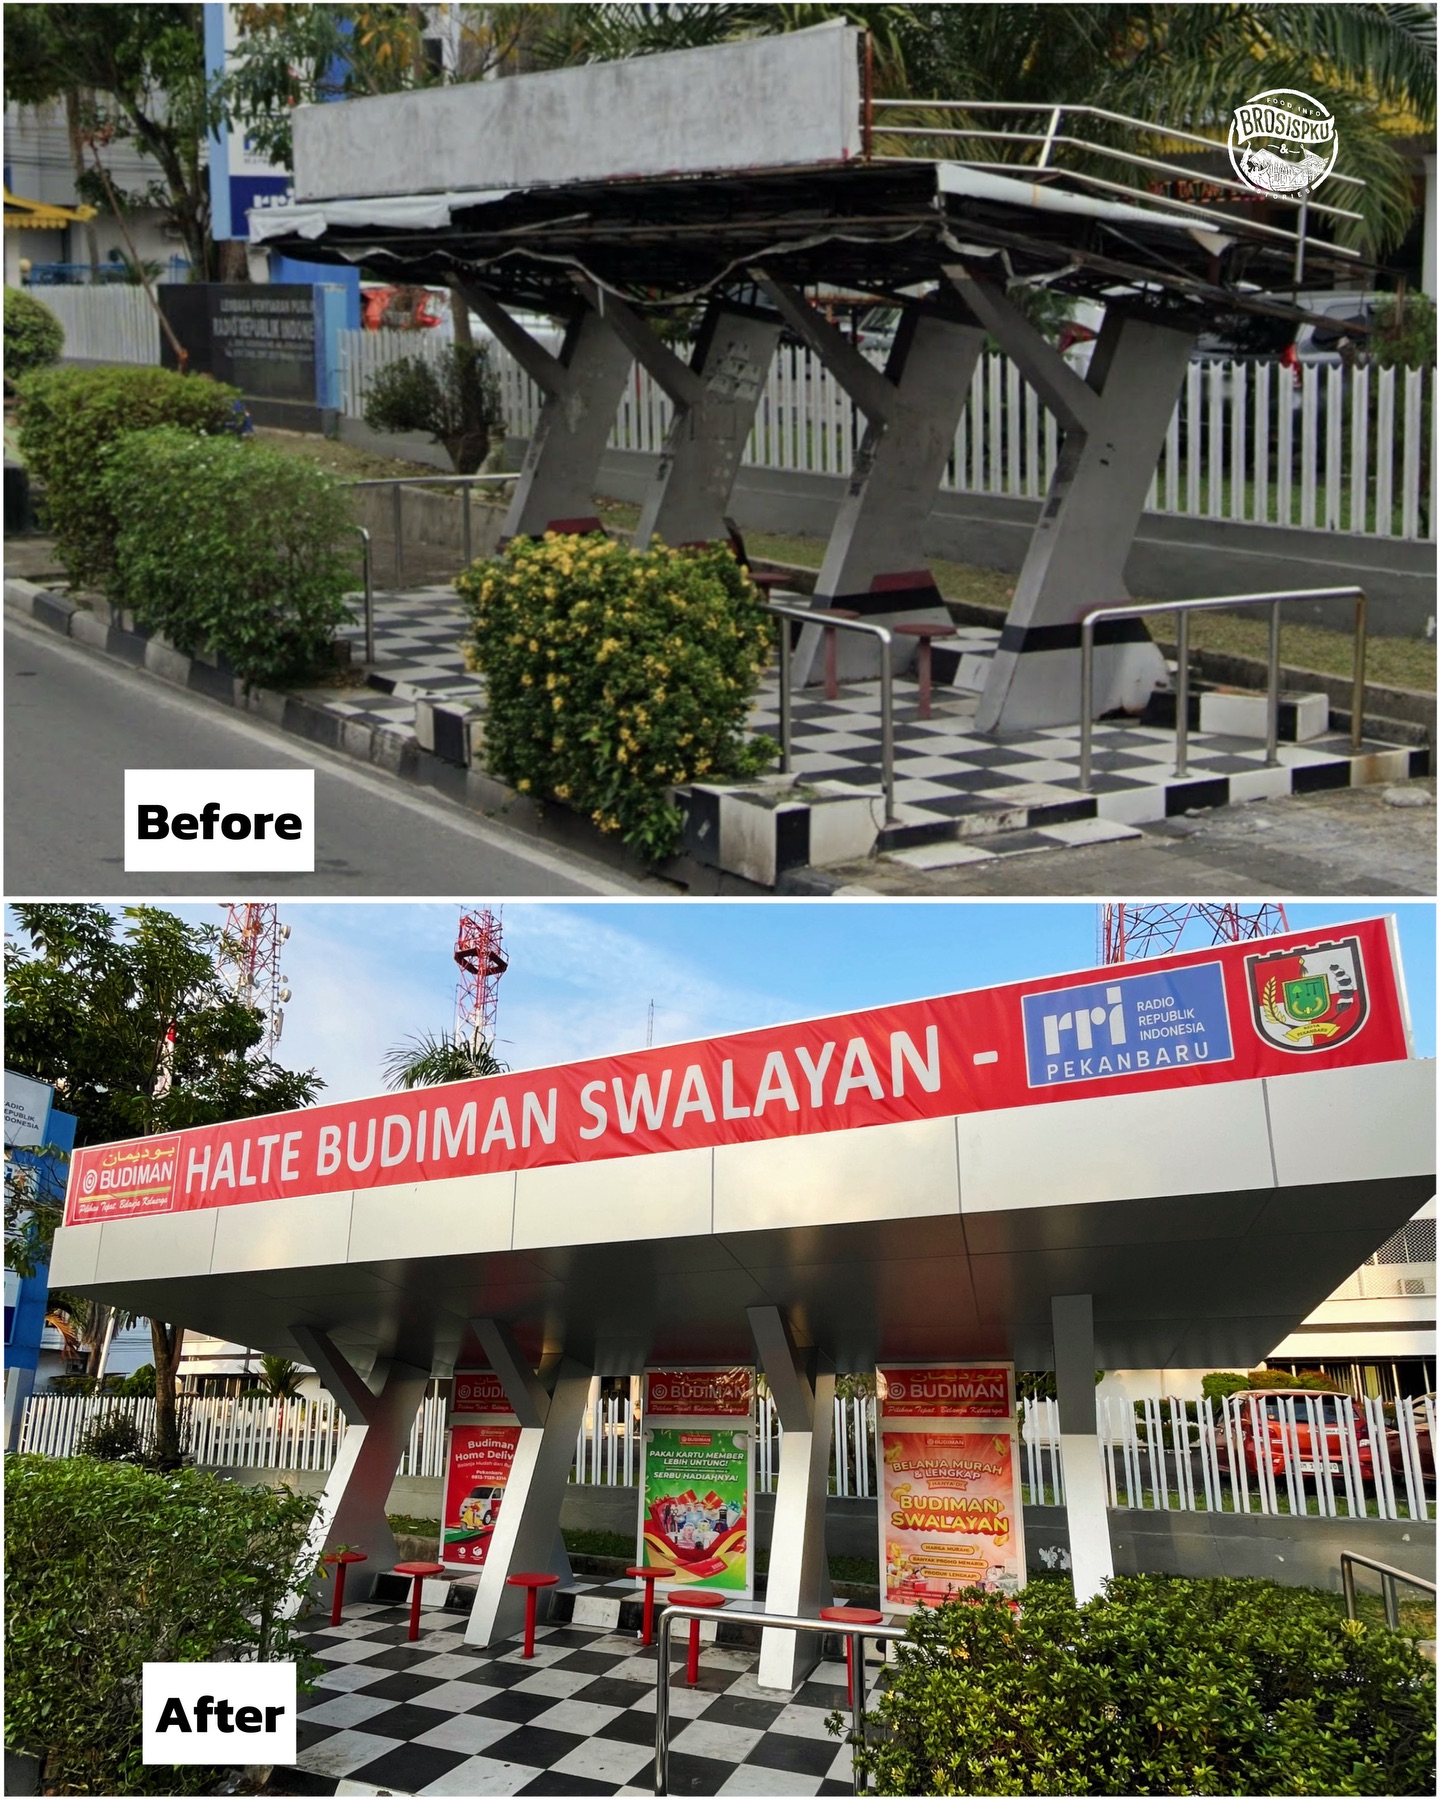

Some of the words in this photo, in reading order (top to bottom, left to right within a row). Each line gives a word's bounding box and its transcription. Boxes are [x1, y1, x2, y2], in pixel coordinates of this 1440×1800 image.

[1136, 996, 1175, 1012] RADIO
[1043, 985, 1127, 1056] rri
[1138, 1008, 1195, 1027] REPUBLIK
[1139, 1021, 1205, 1041] INDONESIA
[1046, 1041, 1209, 1081] PEKANBARU
[4, 1101, 25, 1111] ADIO
[185, 1130, 302, 1194] HALTE
[316, 1088, 558, 1177] BUDIMAN
[579, 1024, 942, 1141] SWALAYAN
[4, 1115, 40, 1130] DONESIA
[100, 1160, 174, 1190] BUDIMAN
[910, 1383, 1004, 1399] BUDIMAN
[467, 1438, 515, 1451] Budiman
[934, 1438, 964, 1446] BUDIMAN
[455, 1452, 485, 1462] Home
[649, 1450, 674, 1458] PAKAI
[675, 1451, 705, 1459] KARTU
[705, 1452, 744, 1460] MEMBER
[663, 1458, 688, 1466] LEBIH
[689, 1459, 729, 1468] UNTUNG!
[892, 1460, 948, 1473] BELANJA
[952, 1460, 1003, 1475] MURAH
[653, 1471, 681, 1480] SERBU
[682, 1473, 739, 1482] HADIAHNYA!
[914, 1470, 923, 1479] &
[925, 1469, 981, 1480] LENGKAP
[900, 1495, 999, 1514] BUDIMAN
[891, 1511, 1009, 1533] SWALAYAN
